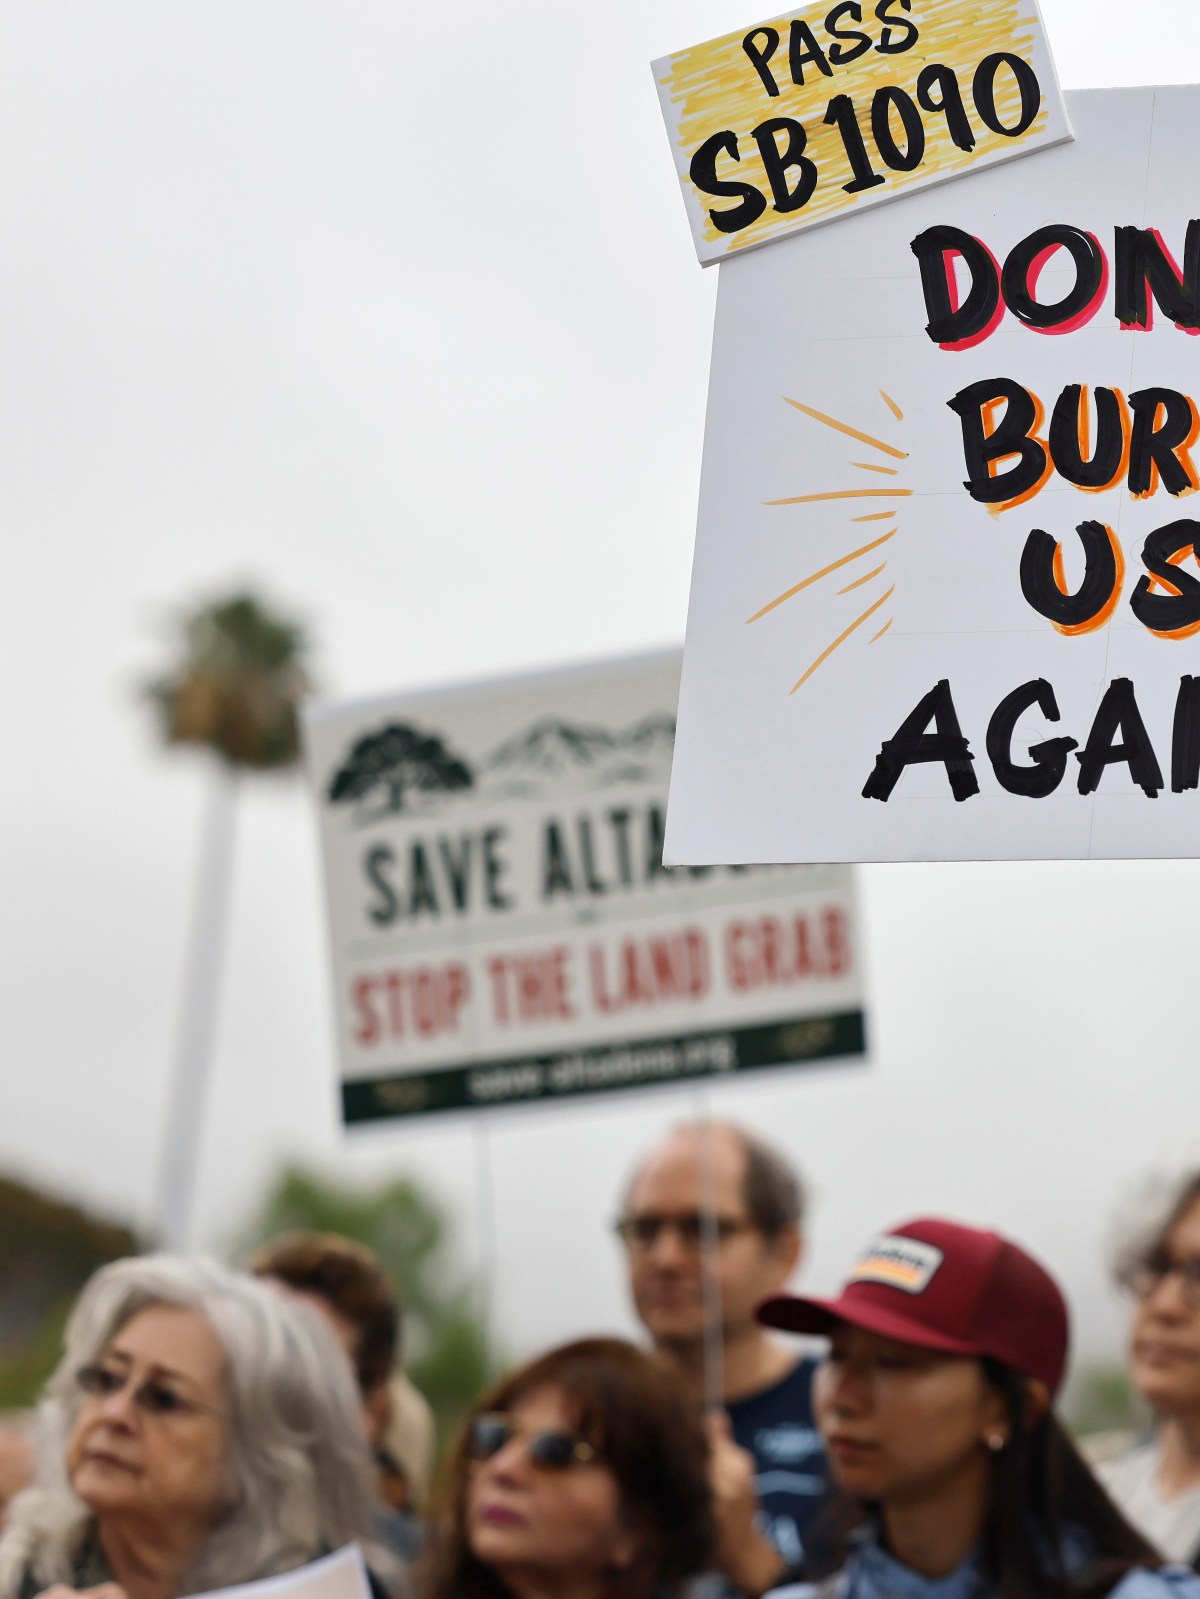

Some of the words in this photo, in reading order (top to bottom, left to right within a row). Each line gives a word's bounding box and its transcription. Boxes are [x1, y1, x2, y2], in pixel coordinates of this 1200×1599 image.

[741, 0, 919, 97] PASS
[365, 824, 512, 927] SAVE
[351, 960, 470, 1046] STOP
[486, 944, 576, 1029] THE
[586, 923, 711, 1016] LAND
[723, 905, 855, 995] GRAB
